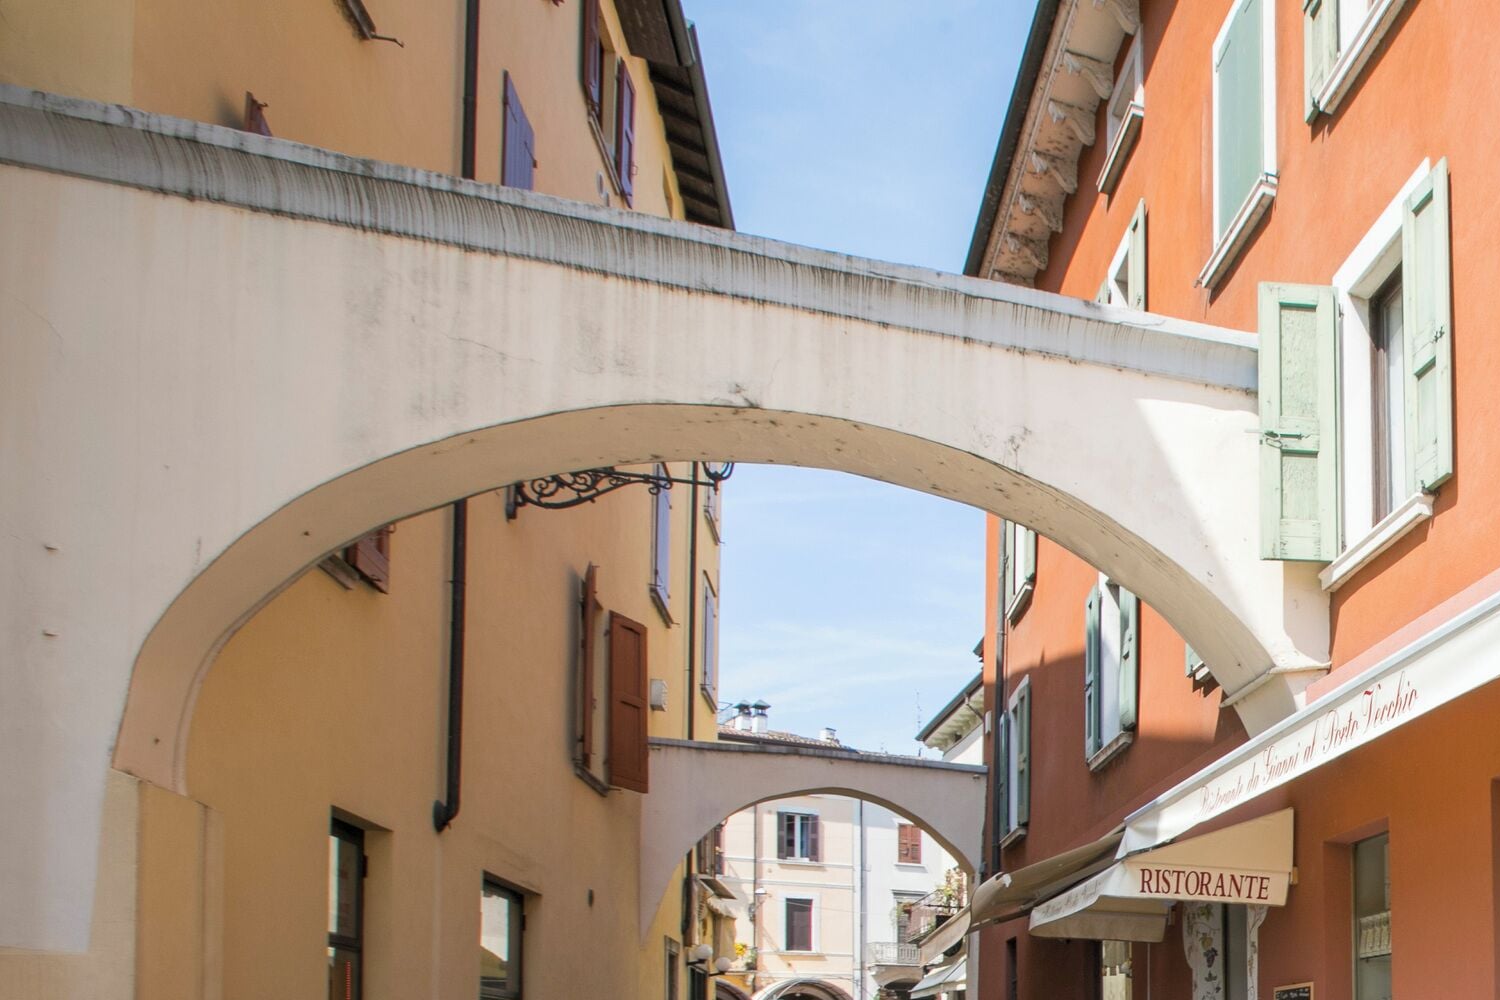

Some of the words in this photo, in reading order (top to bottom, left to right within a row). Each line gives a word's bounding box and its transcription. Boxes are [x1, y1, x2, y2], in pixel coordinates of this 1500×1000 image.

[1303, 719, 1319, 762] al
[1322, 709, 1360, 753] Porto
[1362, 670, 1418, 734] Vecchio
[1139, 868, 1271, 901] RISTORANTE
